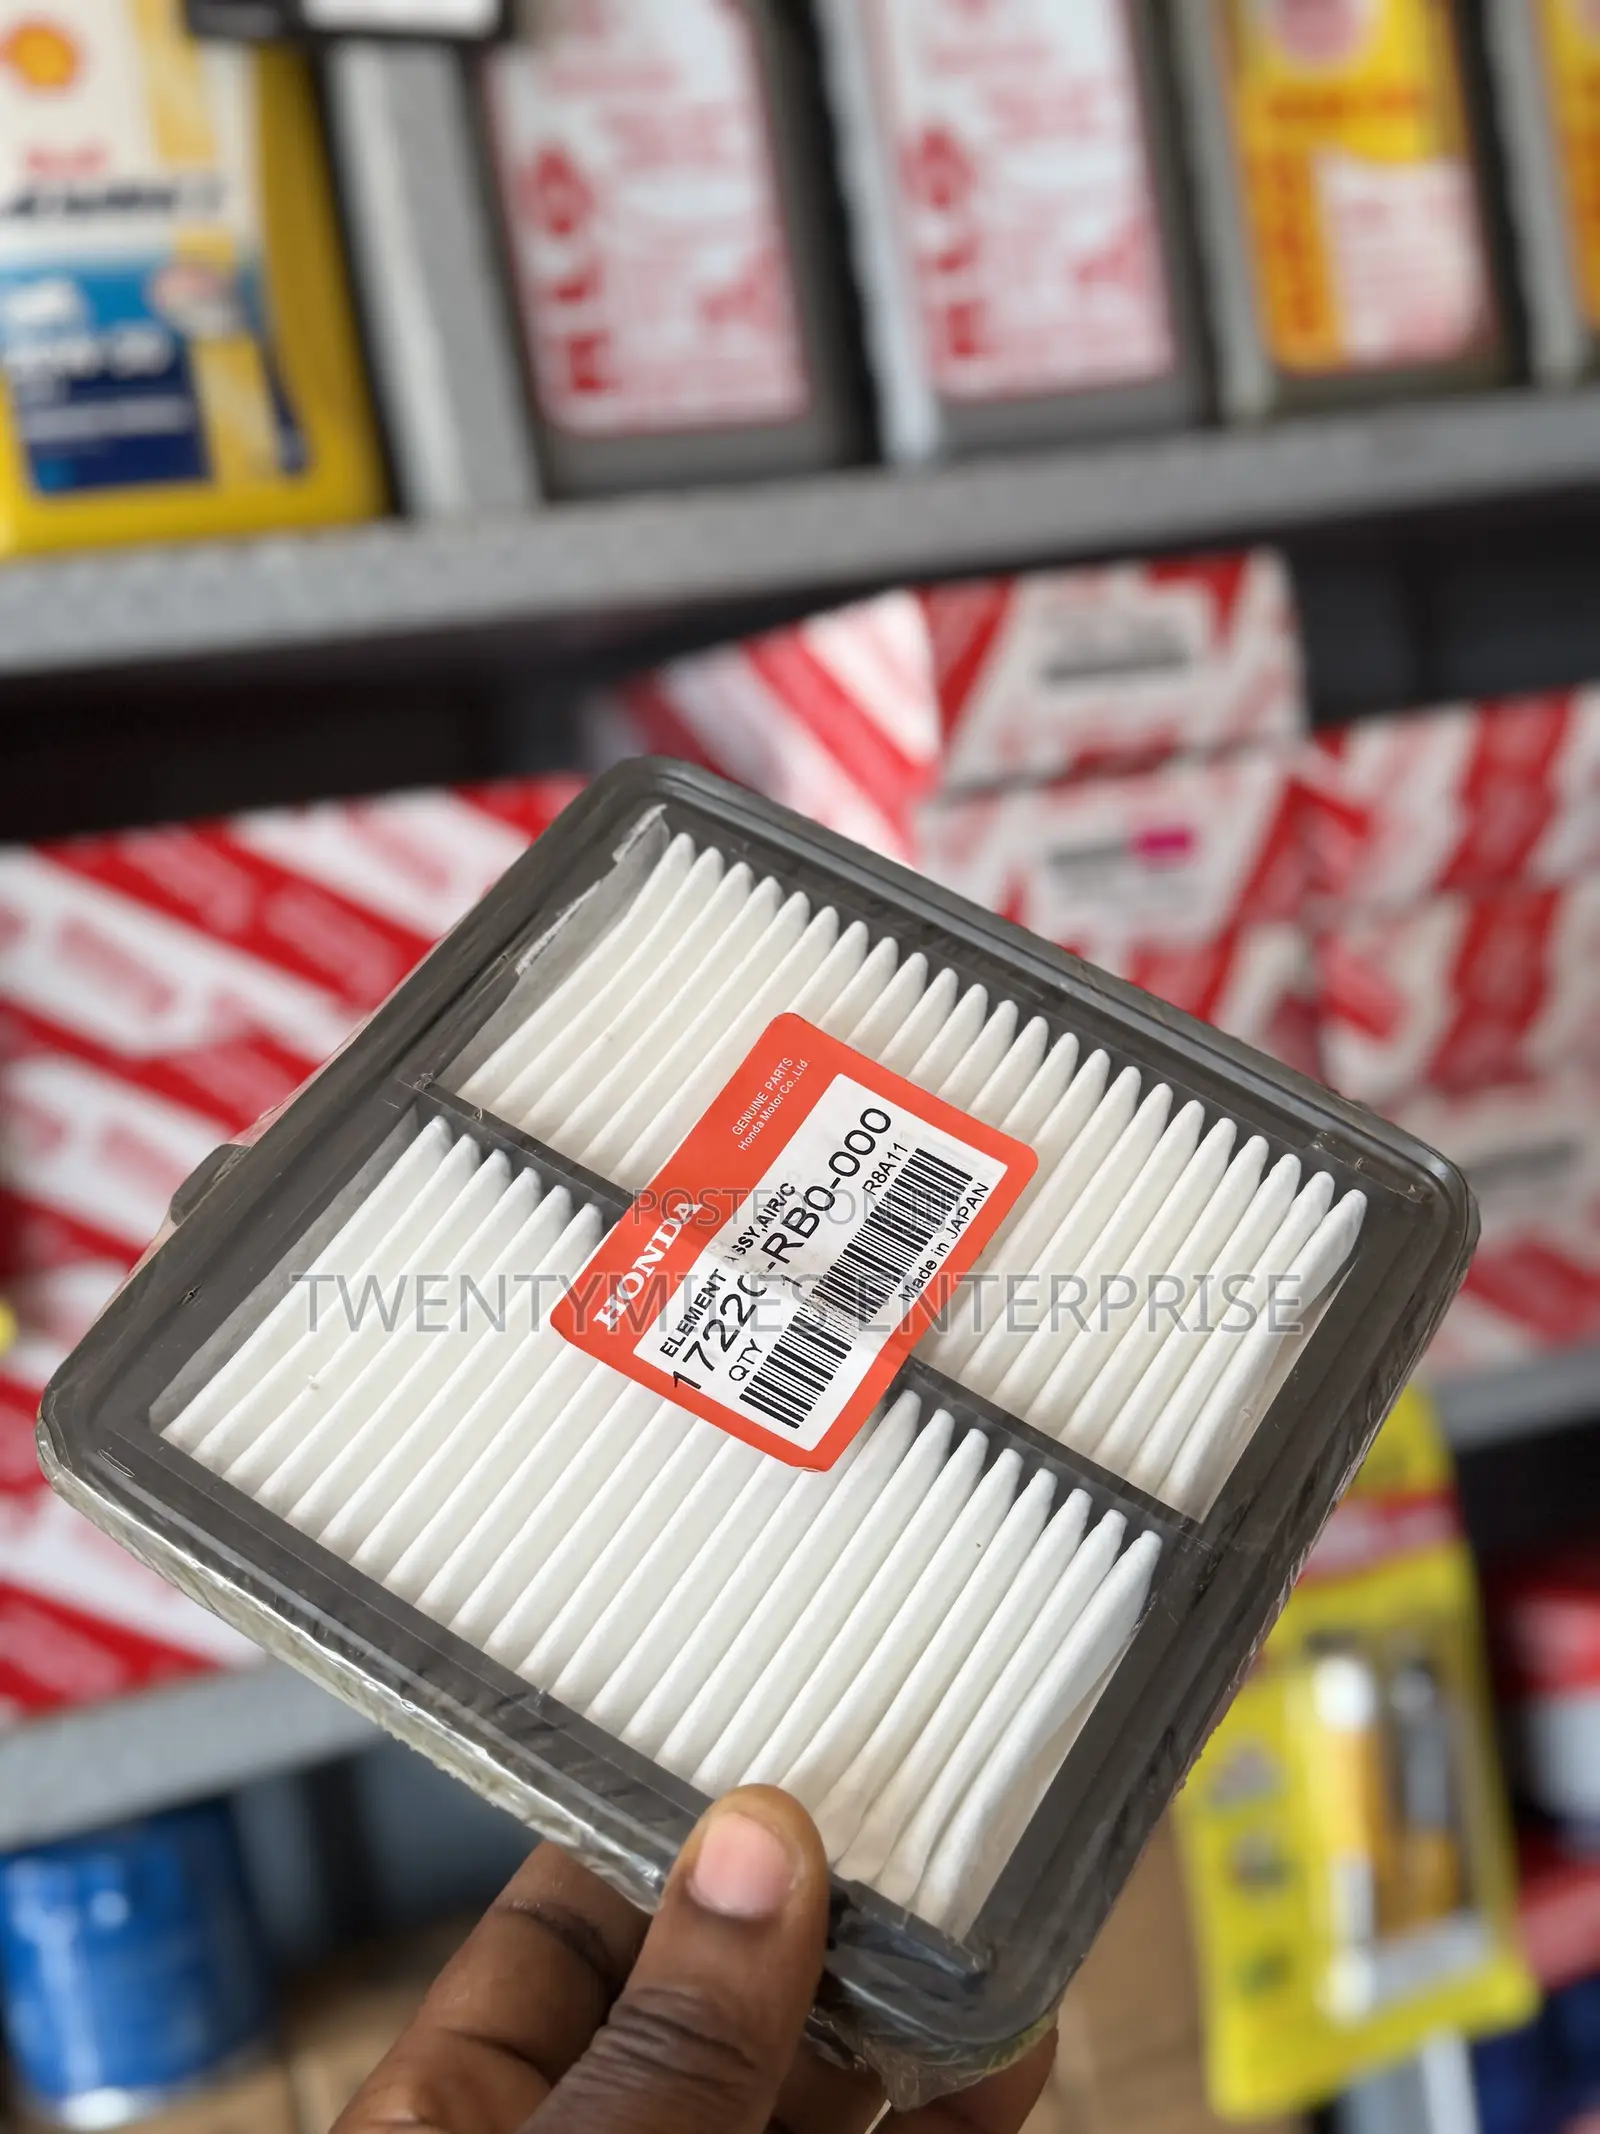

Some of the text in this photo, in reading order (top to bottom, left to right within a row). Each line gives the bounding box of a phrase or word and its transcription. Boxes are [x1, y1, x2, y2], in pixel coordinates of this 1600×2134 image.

[732, 1057, 793, 1136] GENUINE PARTS
[737, 1121, 765, 1151] Honda
[759, 1094, 784, 1121] Motor
[592, 1202, 703, 1331] HONDA
[728, 1338, 763, 1382] QTY
[861, 1141, 909, 1196] R8A11
[898, 1182, 990, 1303] Made in JAPAN
[659, 1268, 726, 1358] ELEMENT
